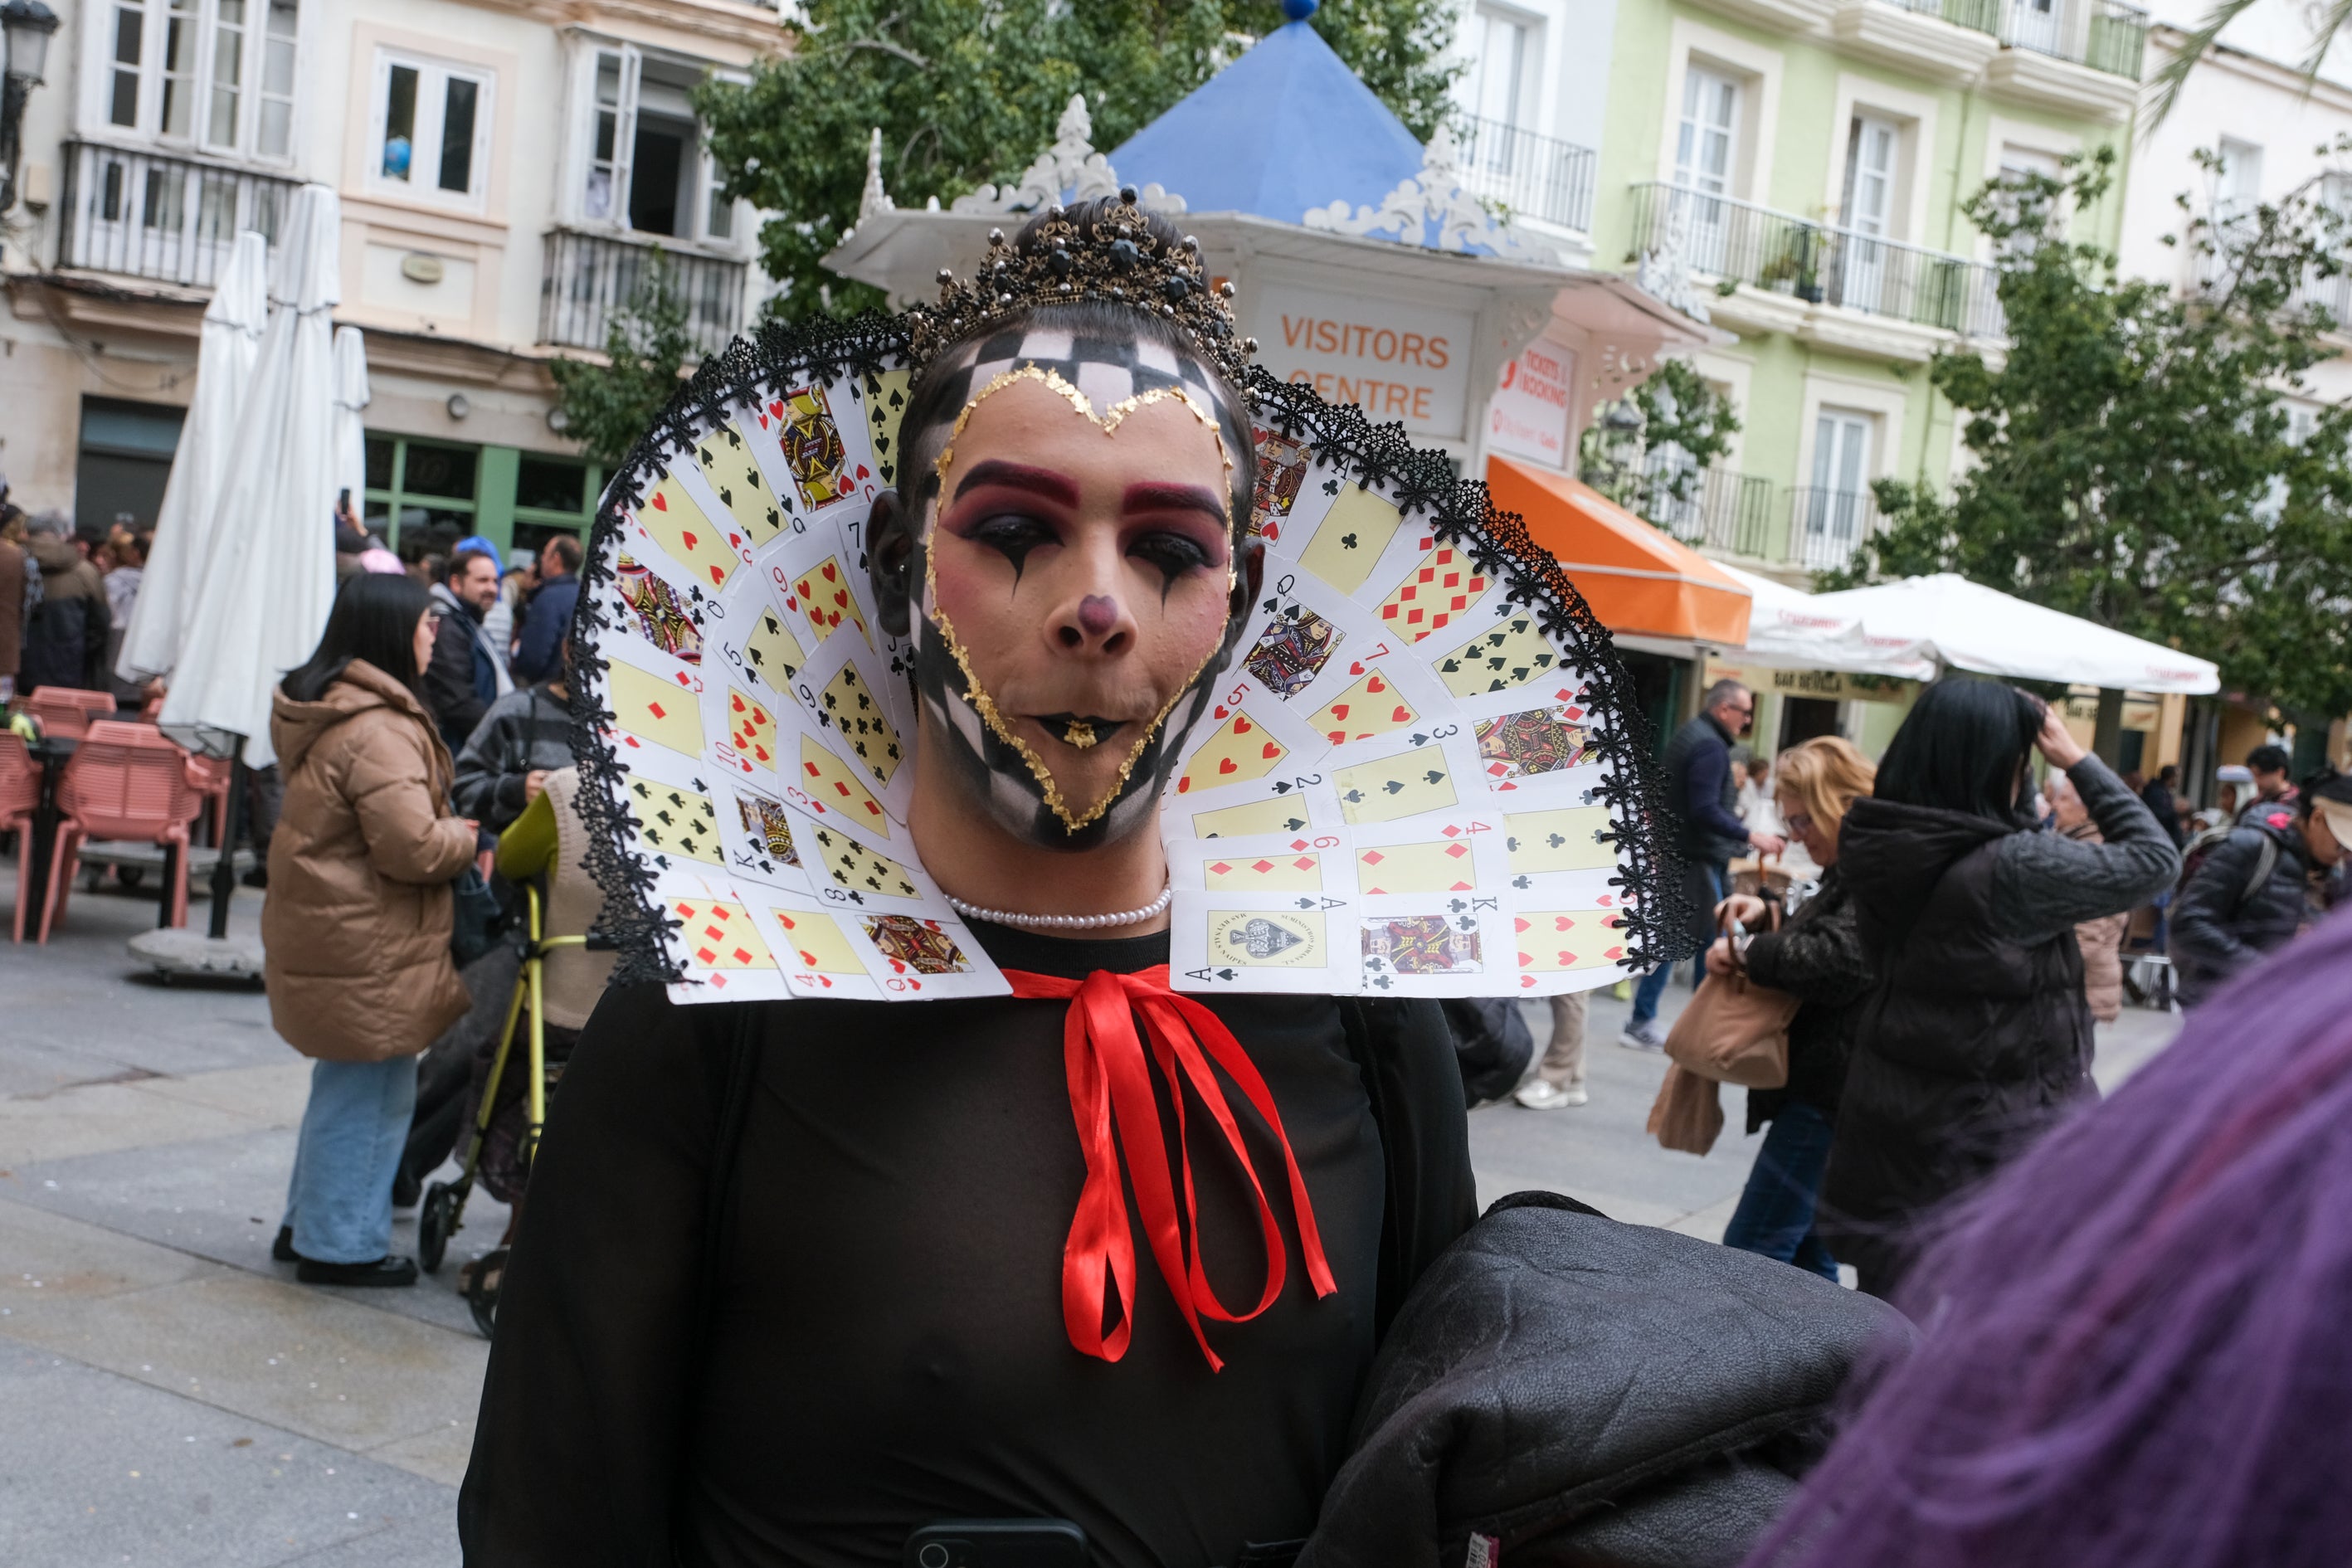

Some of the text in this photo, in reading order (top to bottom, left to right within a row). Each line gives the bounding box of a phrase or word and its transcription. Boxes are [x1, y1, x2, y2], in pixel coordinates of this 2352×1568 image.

[1282, 314, 1449, 369] VISITORS
[1331, 456, 1351, 480] A
[848, 522, 859, 548] 7
[773, 567, 788, 592] 9
[1277, 574, 1294, 597] Q
[707, 600, 724, 619] Q
[723, 641, 742, 666] 5
[1365, 643, 1390, 661] 7
[799, 684, 816, 709] 9
[1227, 683, 1250, 705] 5
[1433, 724, 1458, 739] 3
[715, 742, 737, 768] 10
[1296, 774, 1322, 789] 2
[787, 786, 807, 805] 3
[1466, 821, 1492, 835] 4
[1313, 835, 1340, 849] 6
[733, 850, 756, 871] K
[824, 888, 846, 901] 8
[1321, 897, 1347, 910] A
[1472, 896, 1497, 913] K
[1281, 914, 1315, 942] SUMINISTROS
[1214, 913, 1247, 965] MAS REYNALS NAIPES
[795, 974, 816, 987] 4
[1185, 967, 1211, 982] A
[886, 978, 905, 991] Q
